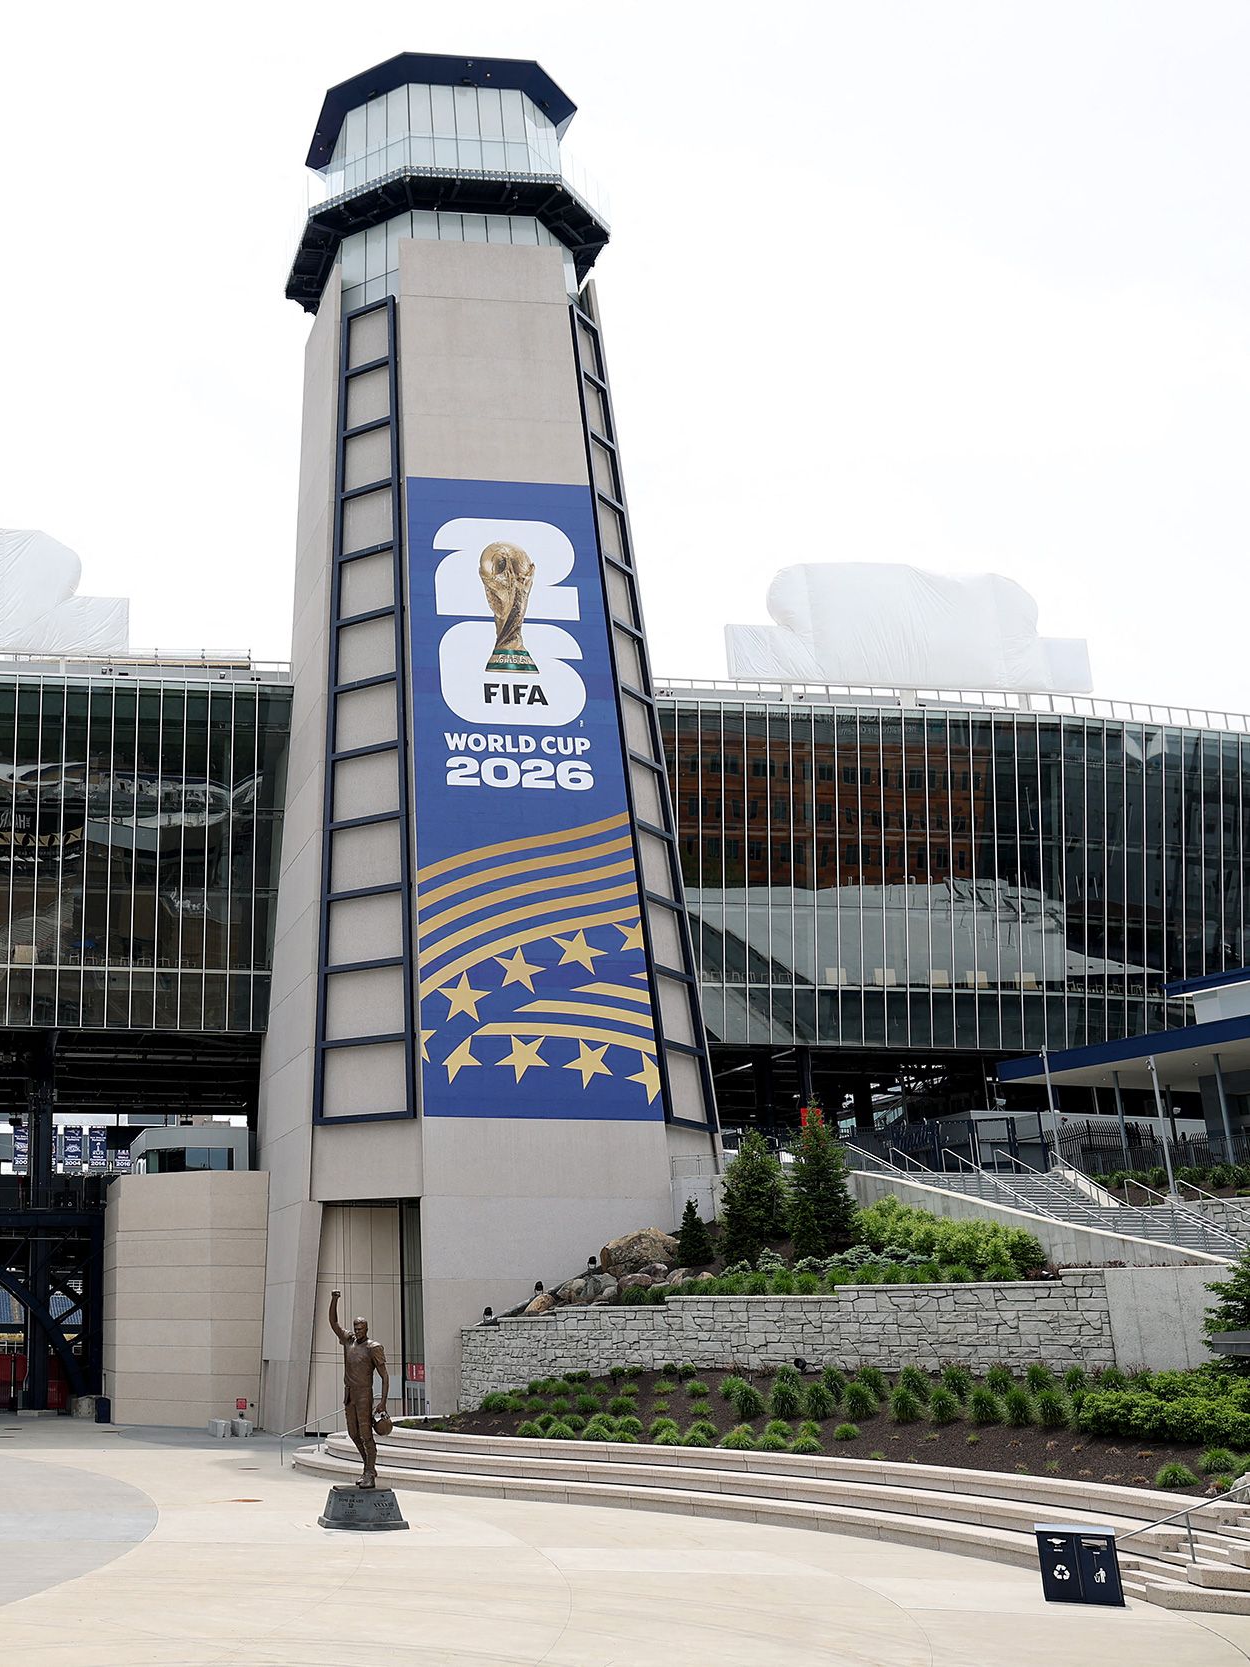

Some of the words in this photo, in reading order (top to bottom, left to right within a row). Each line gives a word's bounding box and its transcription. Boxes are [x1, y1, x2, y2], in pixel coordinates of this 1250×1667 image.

[483, 683, 549, 706] FIFA
[444, 732, 537, 754] WORLD
[540, 735, 591, 756] CUP
[445, 755, 595, 791] 2026
